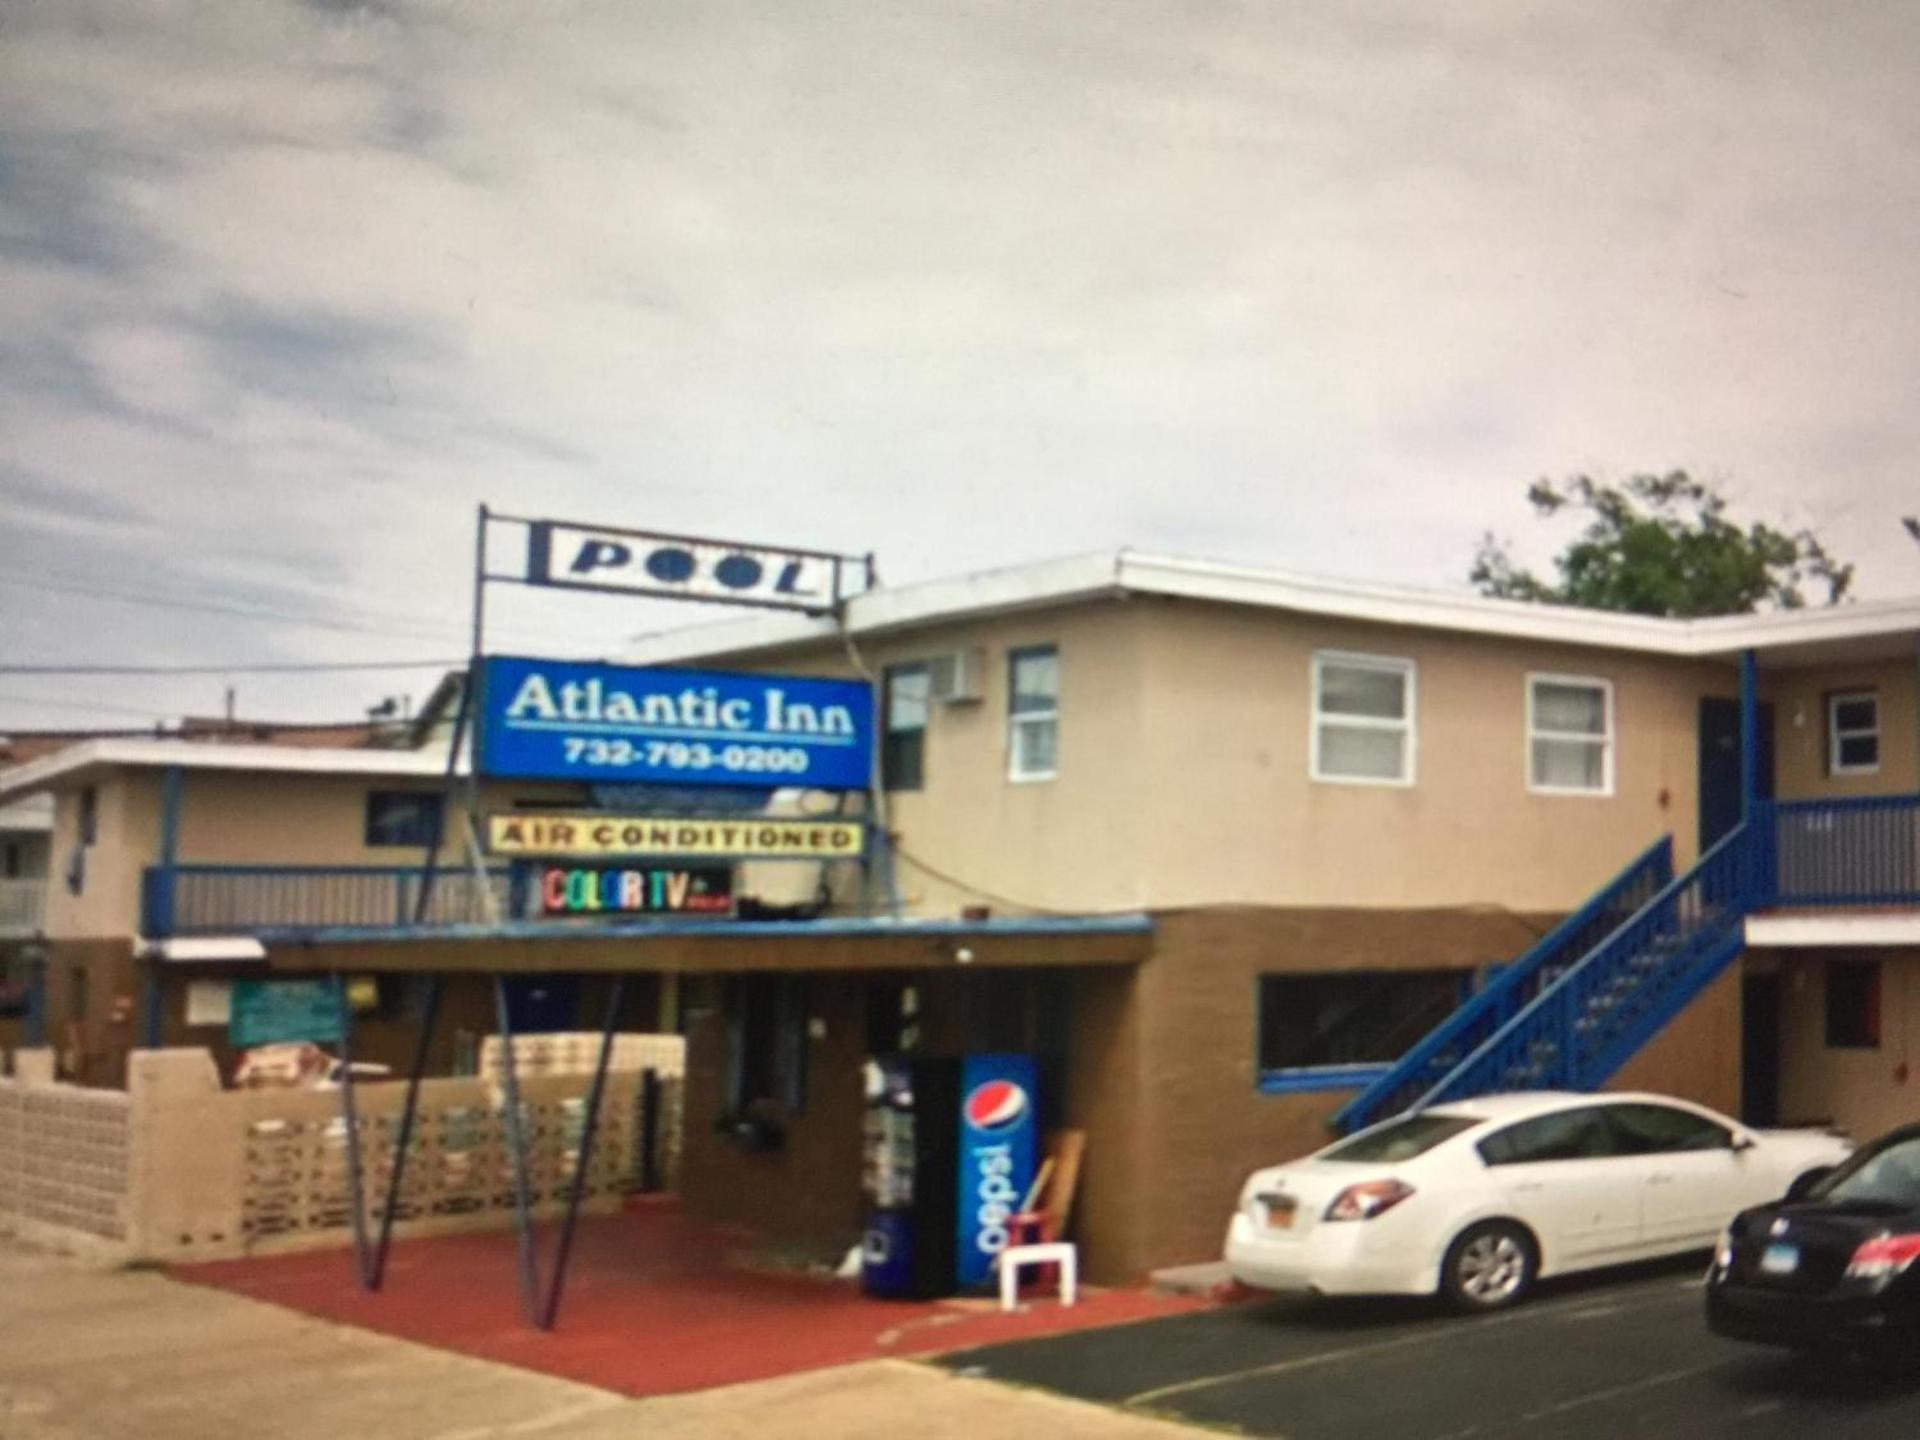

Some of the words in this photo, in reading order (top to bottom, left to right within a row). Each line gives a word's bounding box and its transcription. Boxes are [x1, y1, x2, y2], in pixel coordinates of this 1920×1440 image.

[571, 541, 818, 595] POOL
[506, 673, 752, 731] Atlantic
[764, 689, 854, 733] Inn
[564, 738, 809, 773] 732-793-0200
[502, 817, 576, 845] AIR
[593, 823, 852, 848] CONDITIONED
[543, 869, 644, 909] COLOR
[651, 869, 689, 910] TV
